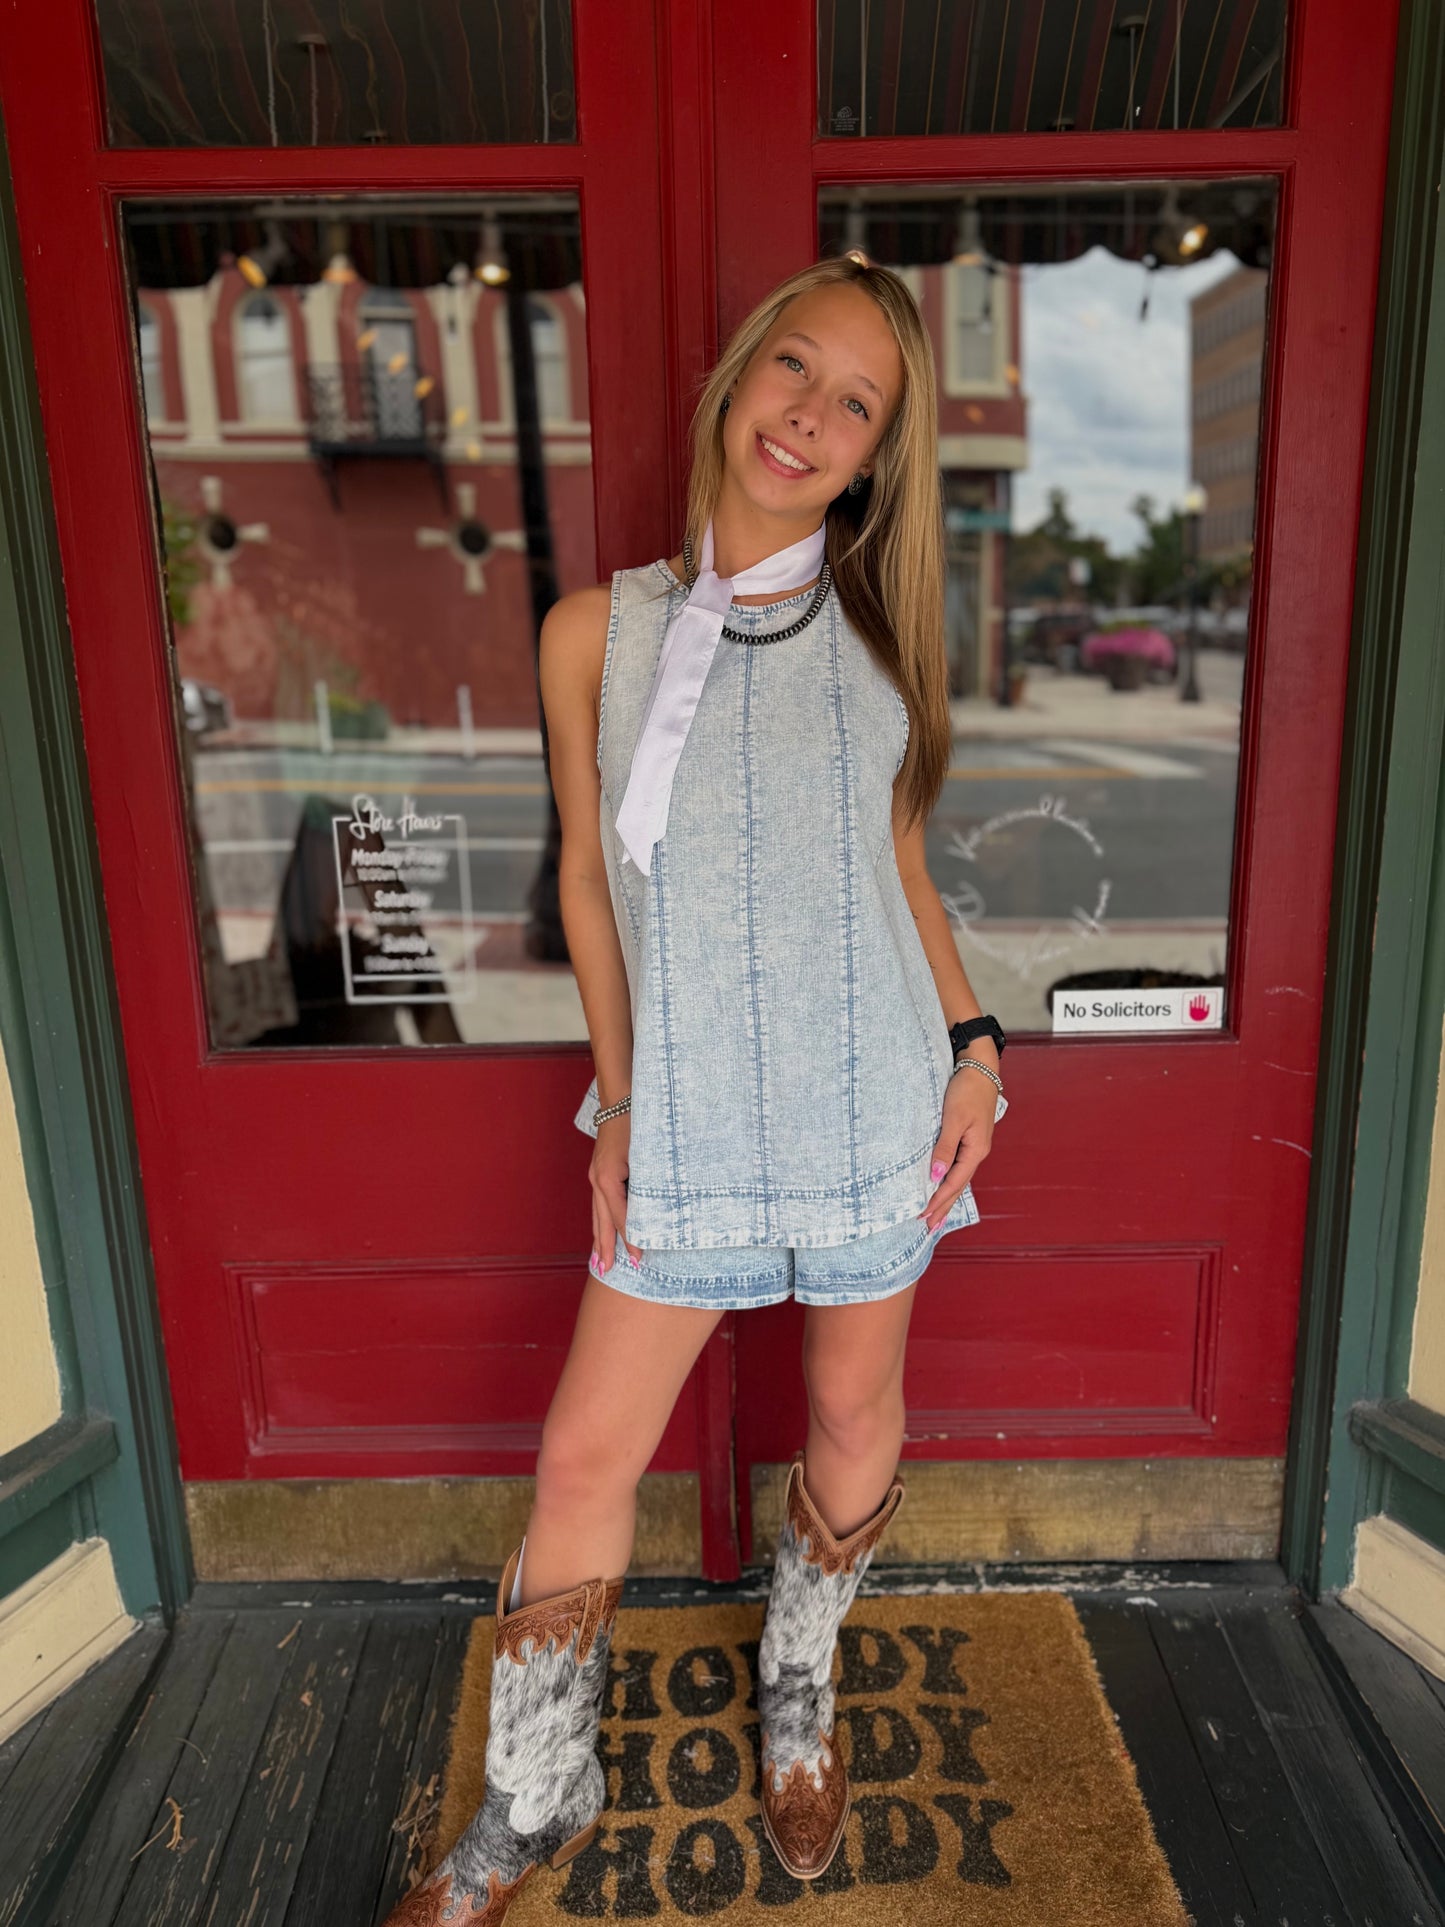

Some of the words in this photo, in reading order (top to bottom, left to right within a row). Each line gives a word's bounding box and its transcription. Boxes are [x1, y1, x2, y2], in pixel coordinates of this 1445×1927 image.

[1064, 1003, 1087, 1018] No
[1091, 1001, 1172, 1018] Solicitors
[600, 1625, 971, 1720] HODY
[600, 1705, 991, 1811] HODY
